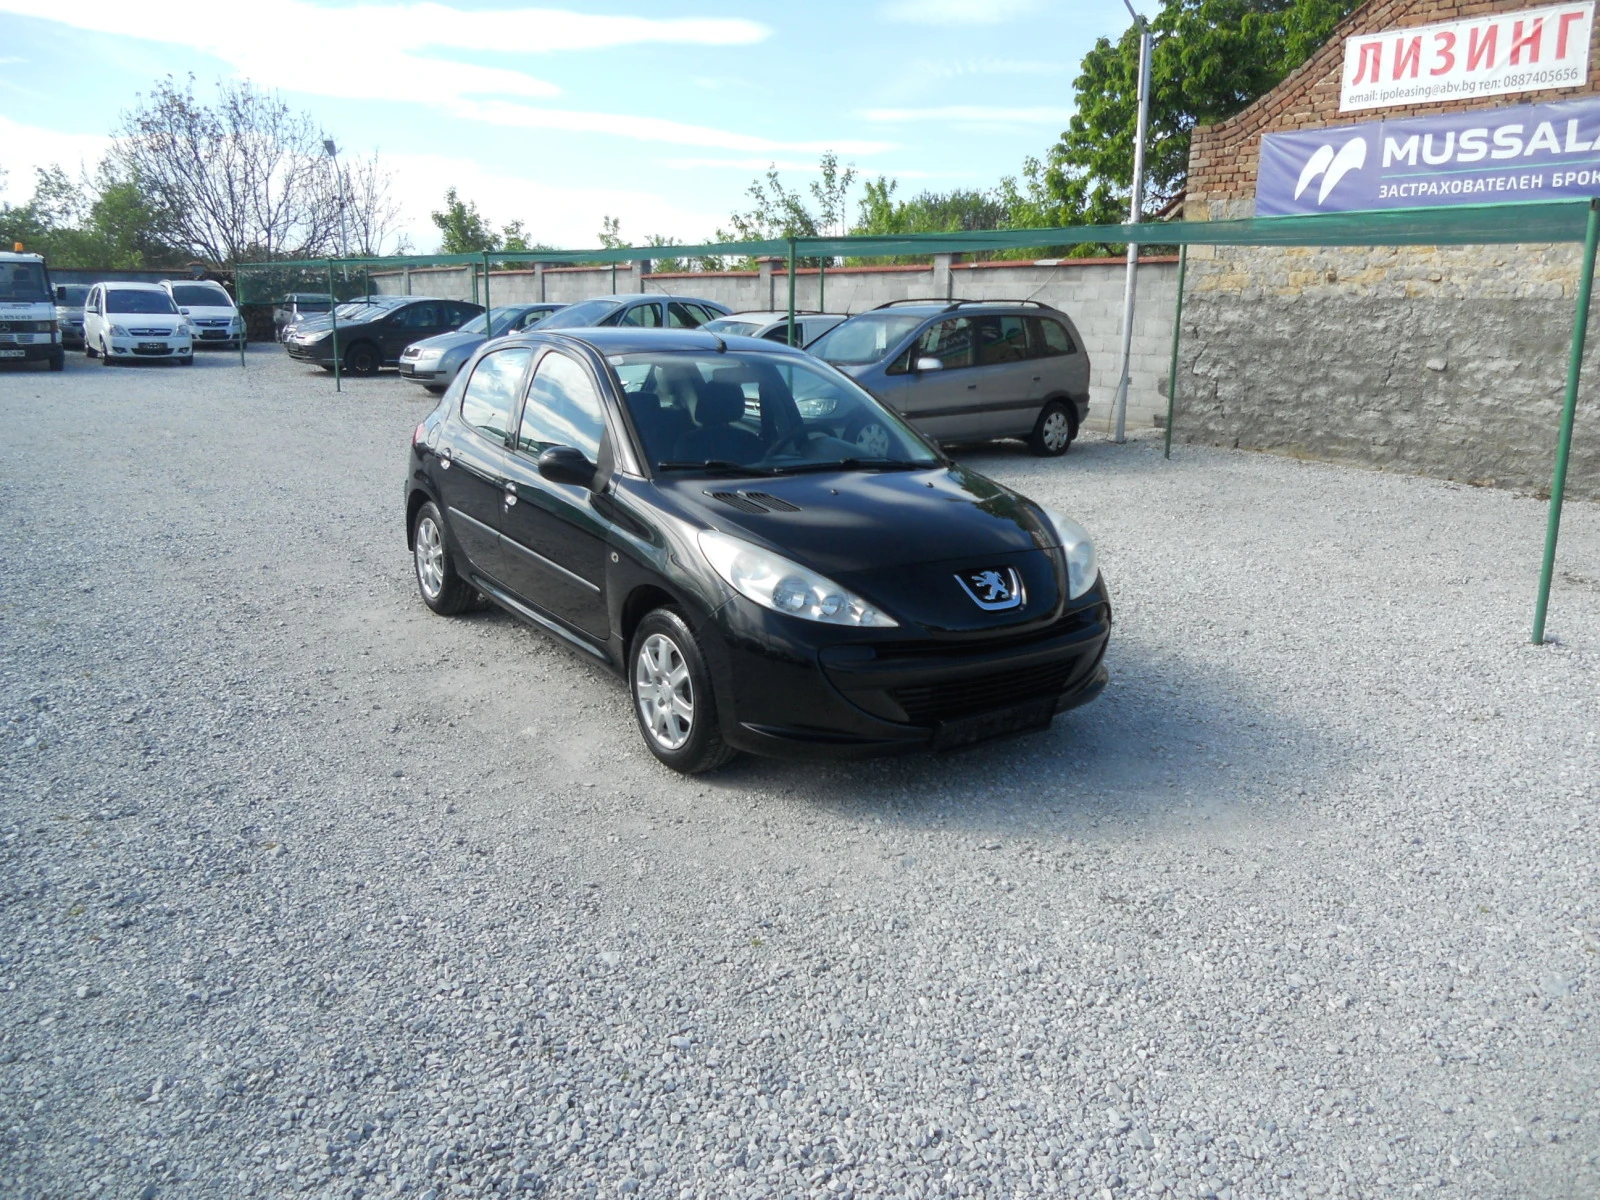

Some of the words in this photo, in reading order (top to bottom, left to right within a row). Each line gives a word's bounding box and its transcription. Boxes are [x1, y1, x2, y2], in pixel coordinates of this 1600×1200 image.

[1352, 11, 1584, 86] ЛИЗИНГ
[1349, 89, 1378, 104] email:
[1380, 79, 1476, 102] ipoleasing@abv.bg
[1479, 79, 1501, 91] тел:
[1503, 67, 1578, 88] 0887405656
[1382, 119, 1600, 168] MUSSAL
[1379, 174, 1543, 199] ЗАСТРАХОВАТЕЛЕН
